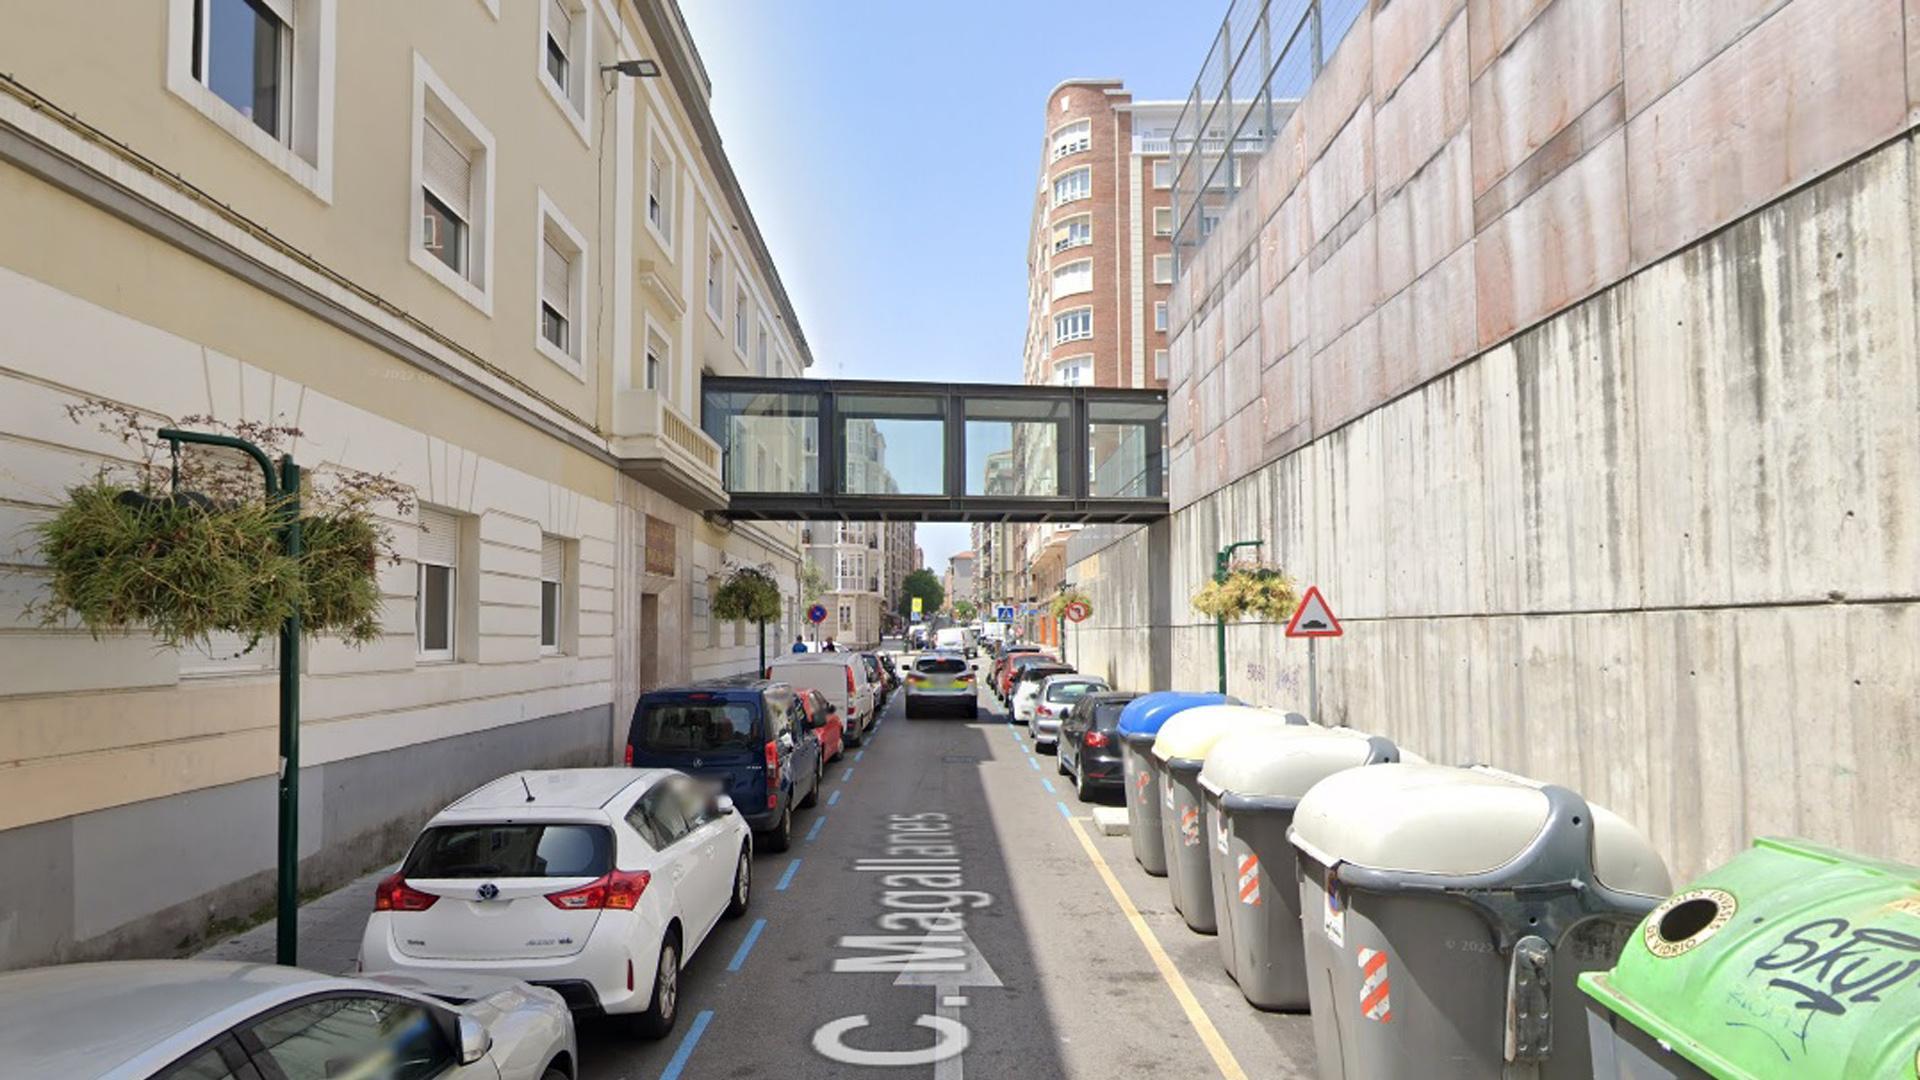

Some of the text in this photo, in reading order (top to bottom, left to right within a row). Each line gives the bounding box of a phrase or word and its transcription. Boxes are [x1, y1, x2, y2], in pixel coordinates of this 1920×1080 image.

[1708, 890, 1734, 930] ENVASES
[812, 812, 994, 1066] C. Magallanes
[1646, 924, 1697, 955] DE VIDRIO
